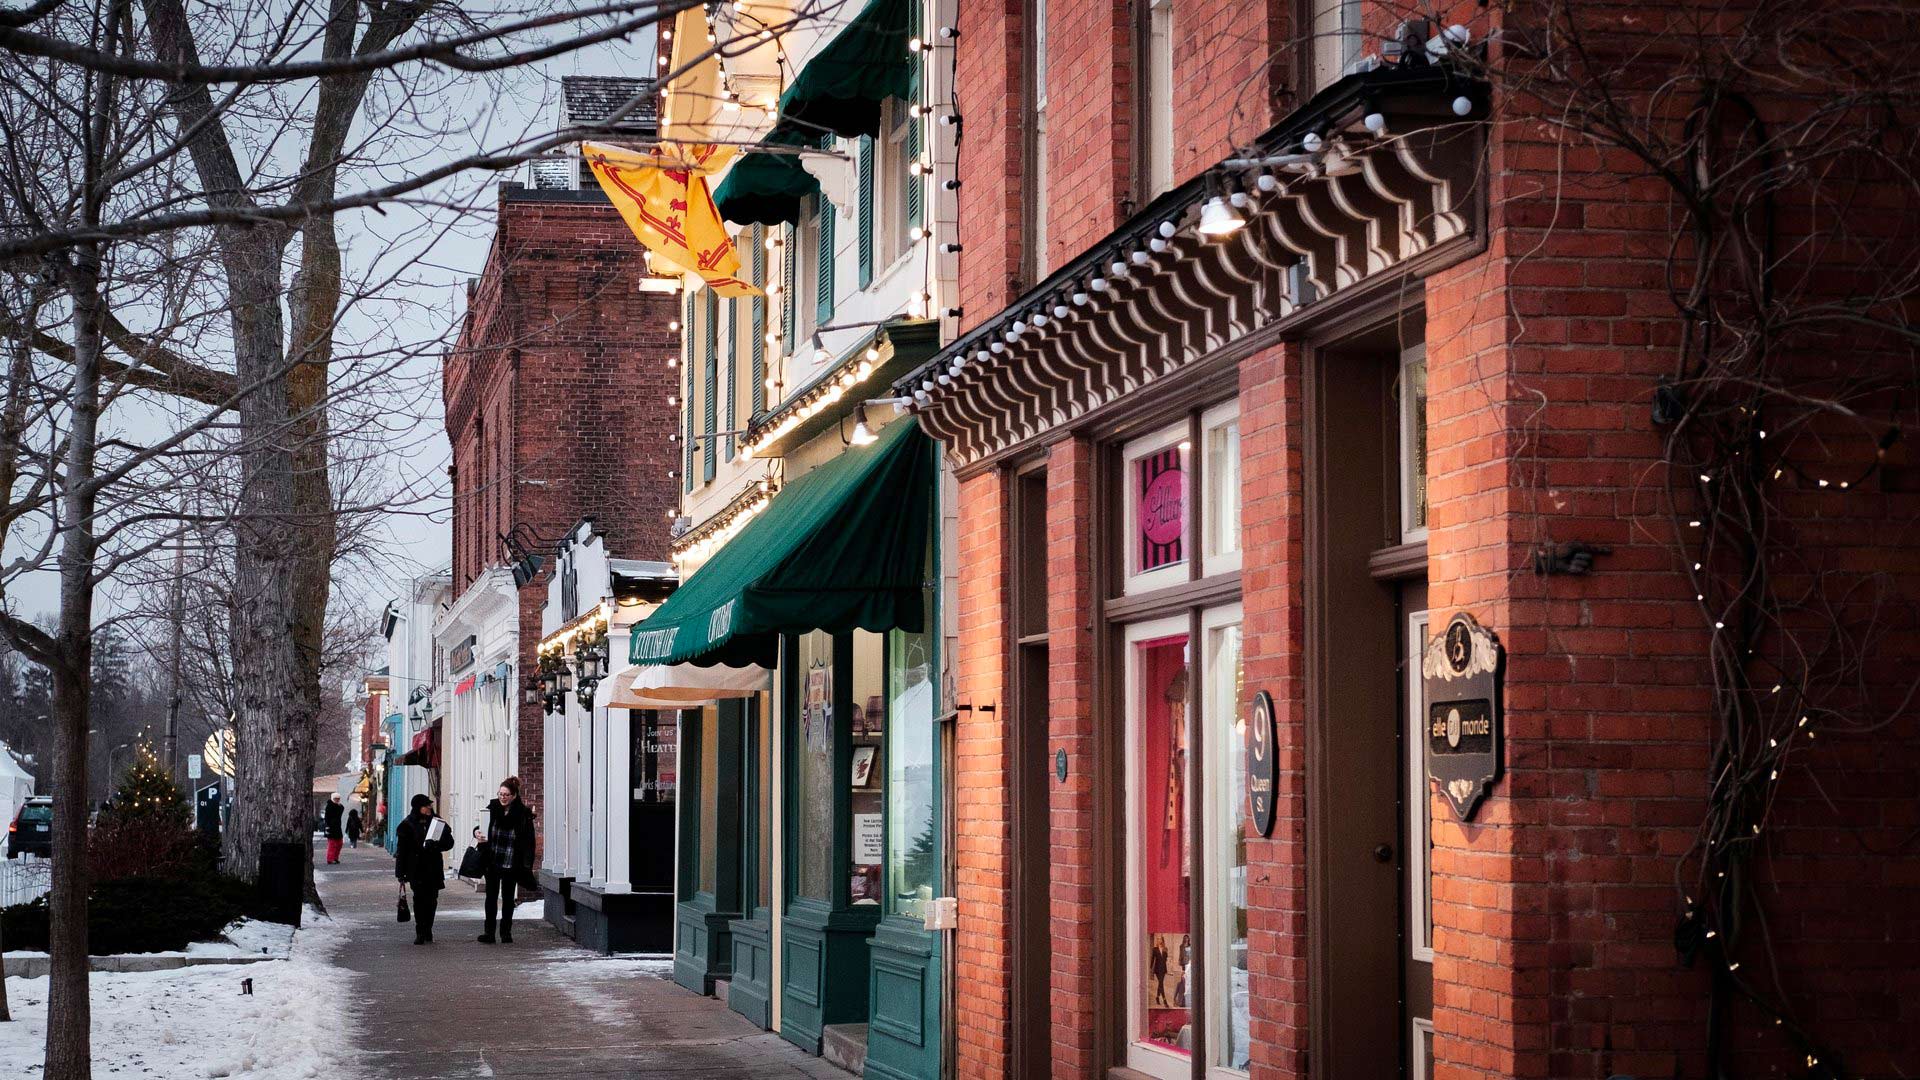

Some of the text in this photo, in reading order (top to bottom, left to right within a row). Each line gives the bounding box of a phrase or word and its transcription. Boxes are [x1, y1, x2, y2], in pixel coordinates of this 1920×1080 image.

[1254, 706, 1264, 761] 9
[1432, 716, 1446, 737] elle
[1462, 714, 1489, 736] monde
[208, 787, 217, 799] P
[1251, 774, 1270, 792] Queen
